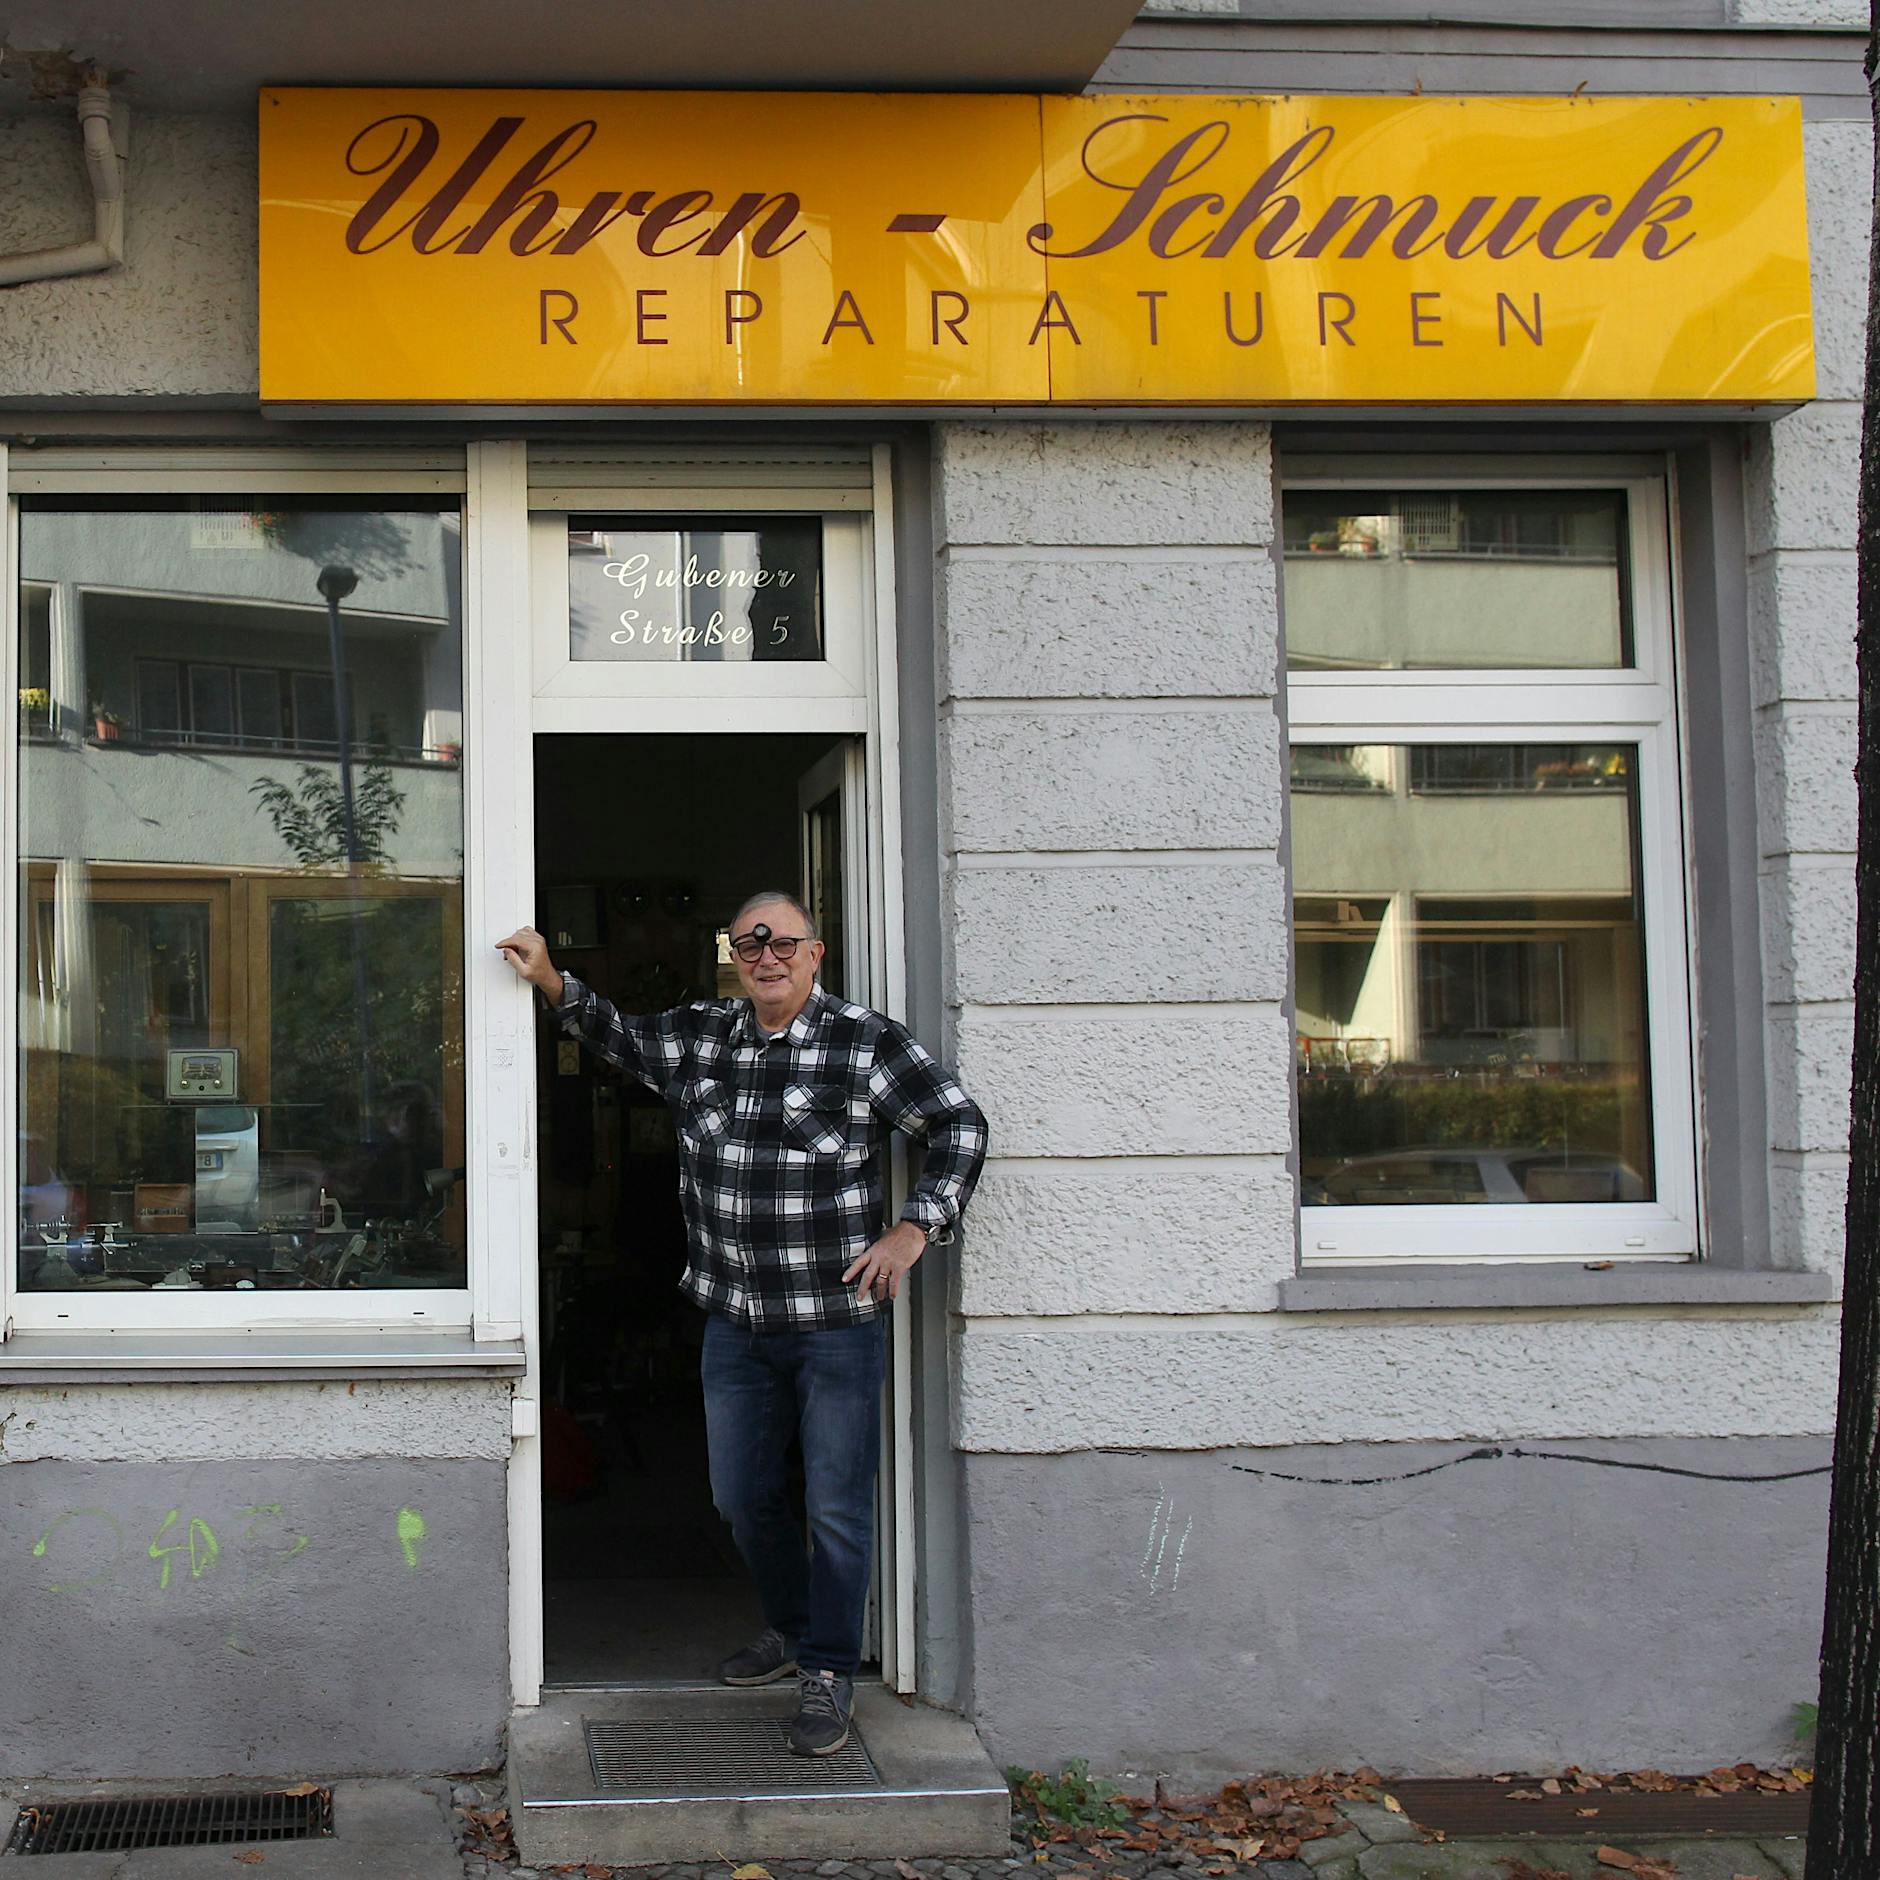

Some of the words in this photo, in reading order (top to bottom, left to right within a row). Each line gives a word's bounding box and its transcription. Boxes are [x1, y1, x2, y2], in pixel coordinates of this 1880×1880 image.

[345, 113, 807, 258] Uhren
[1026, 114, 1724, 262] Schmuck
[539, 289, 1543, 346] REPARATUREN
[602, 553, 796, 600] Gubener
[610, 609, 754, 648] Straße
[769, 615, 790, 645] 5
